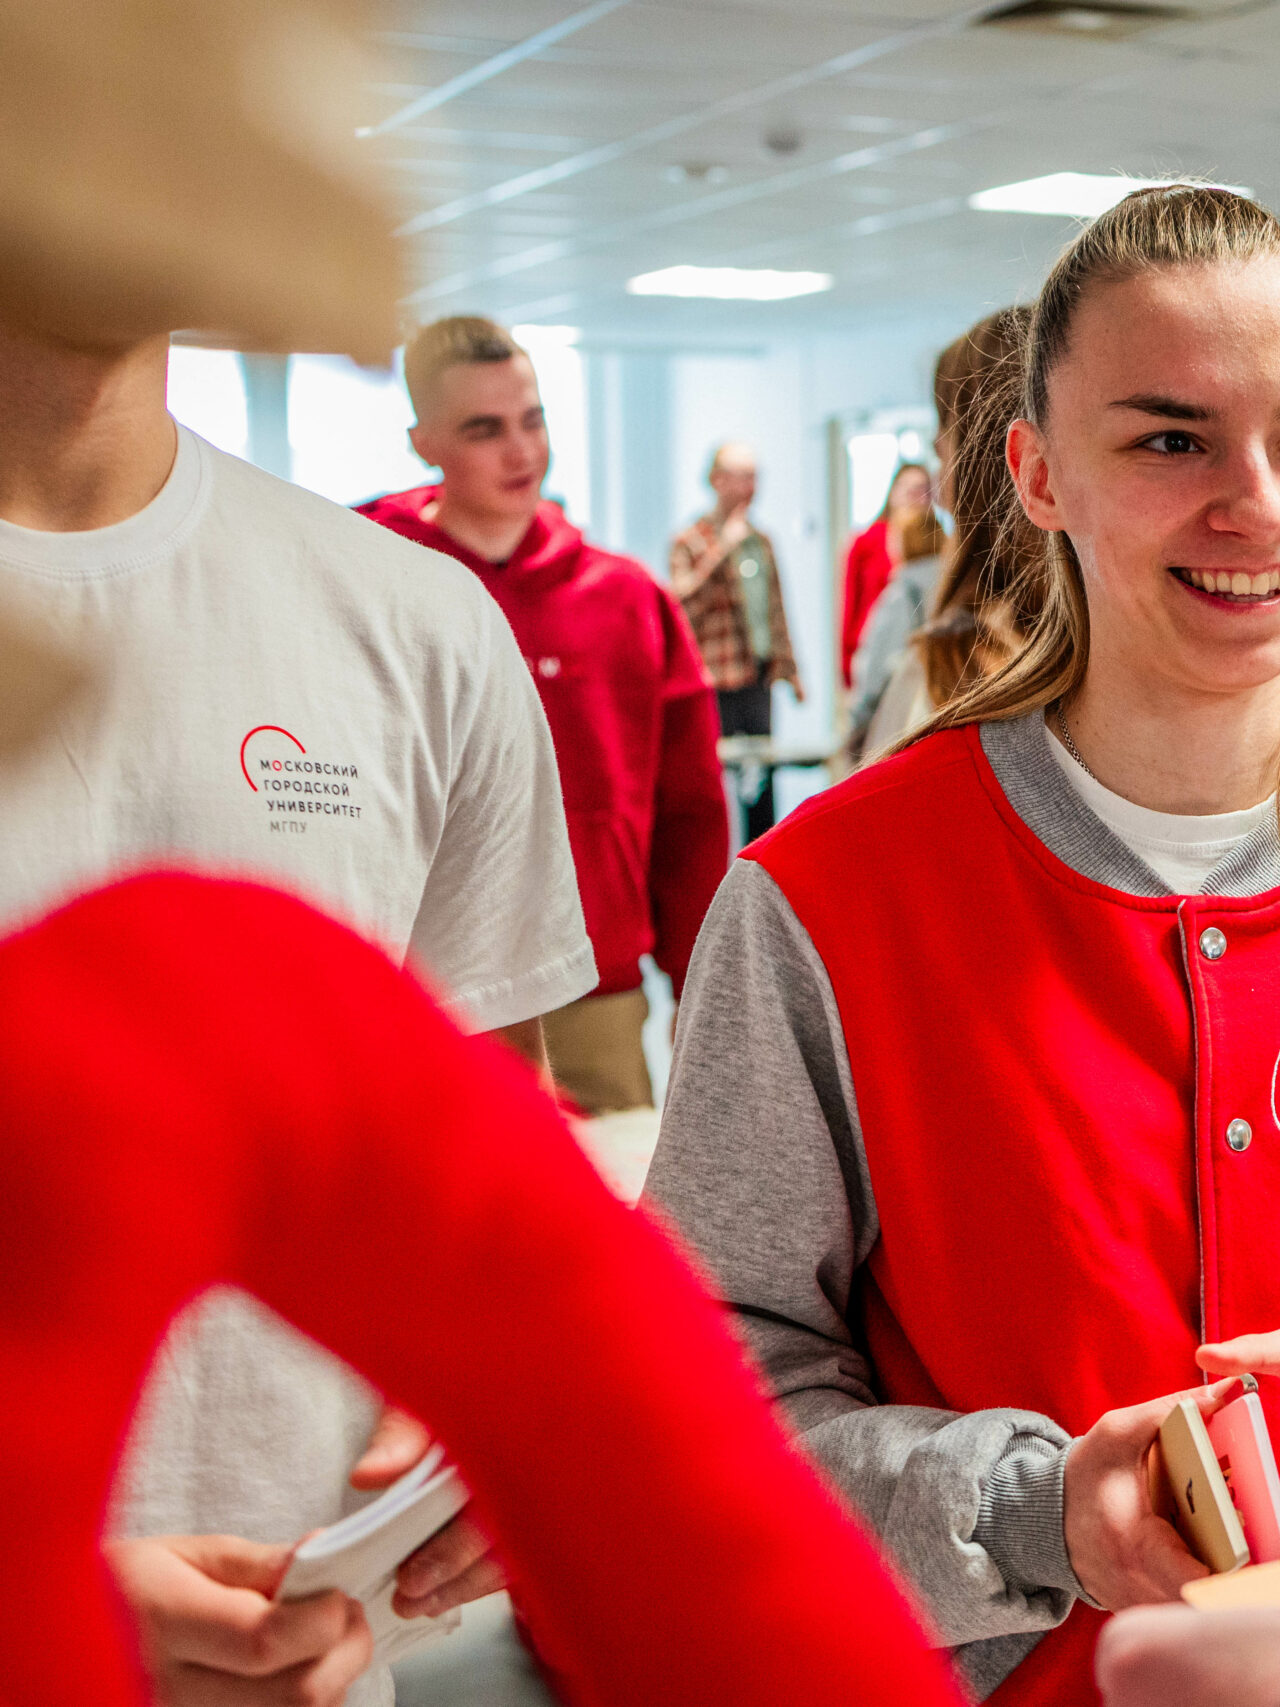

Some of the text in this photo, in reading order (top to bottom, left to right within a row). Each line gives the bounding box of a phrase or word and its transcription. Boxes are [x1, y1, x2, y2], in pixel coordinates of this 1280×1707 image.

[260, 760, 358, 778] МОСКОВСКИЙ
[264, 779, 350, 796] ГОРОДСКОЙ
[267, 800, 361, 818] УНИВЕРСИТЕТ
[270, 821, 307, 833] МГПУ
